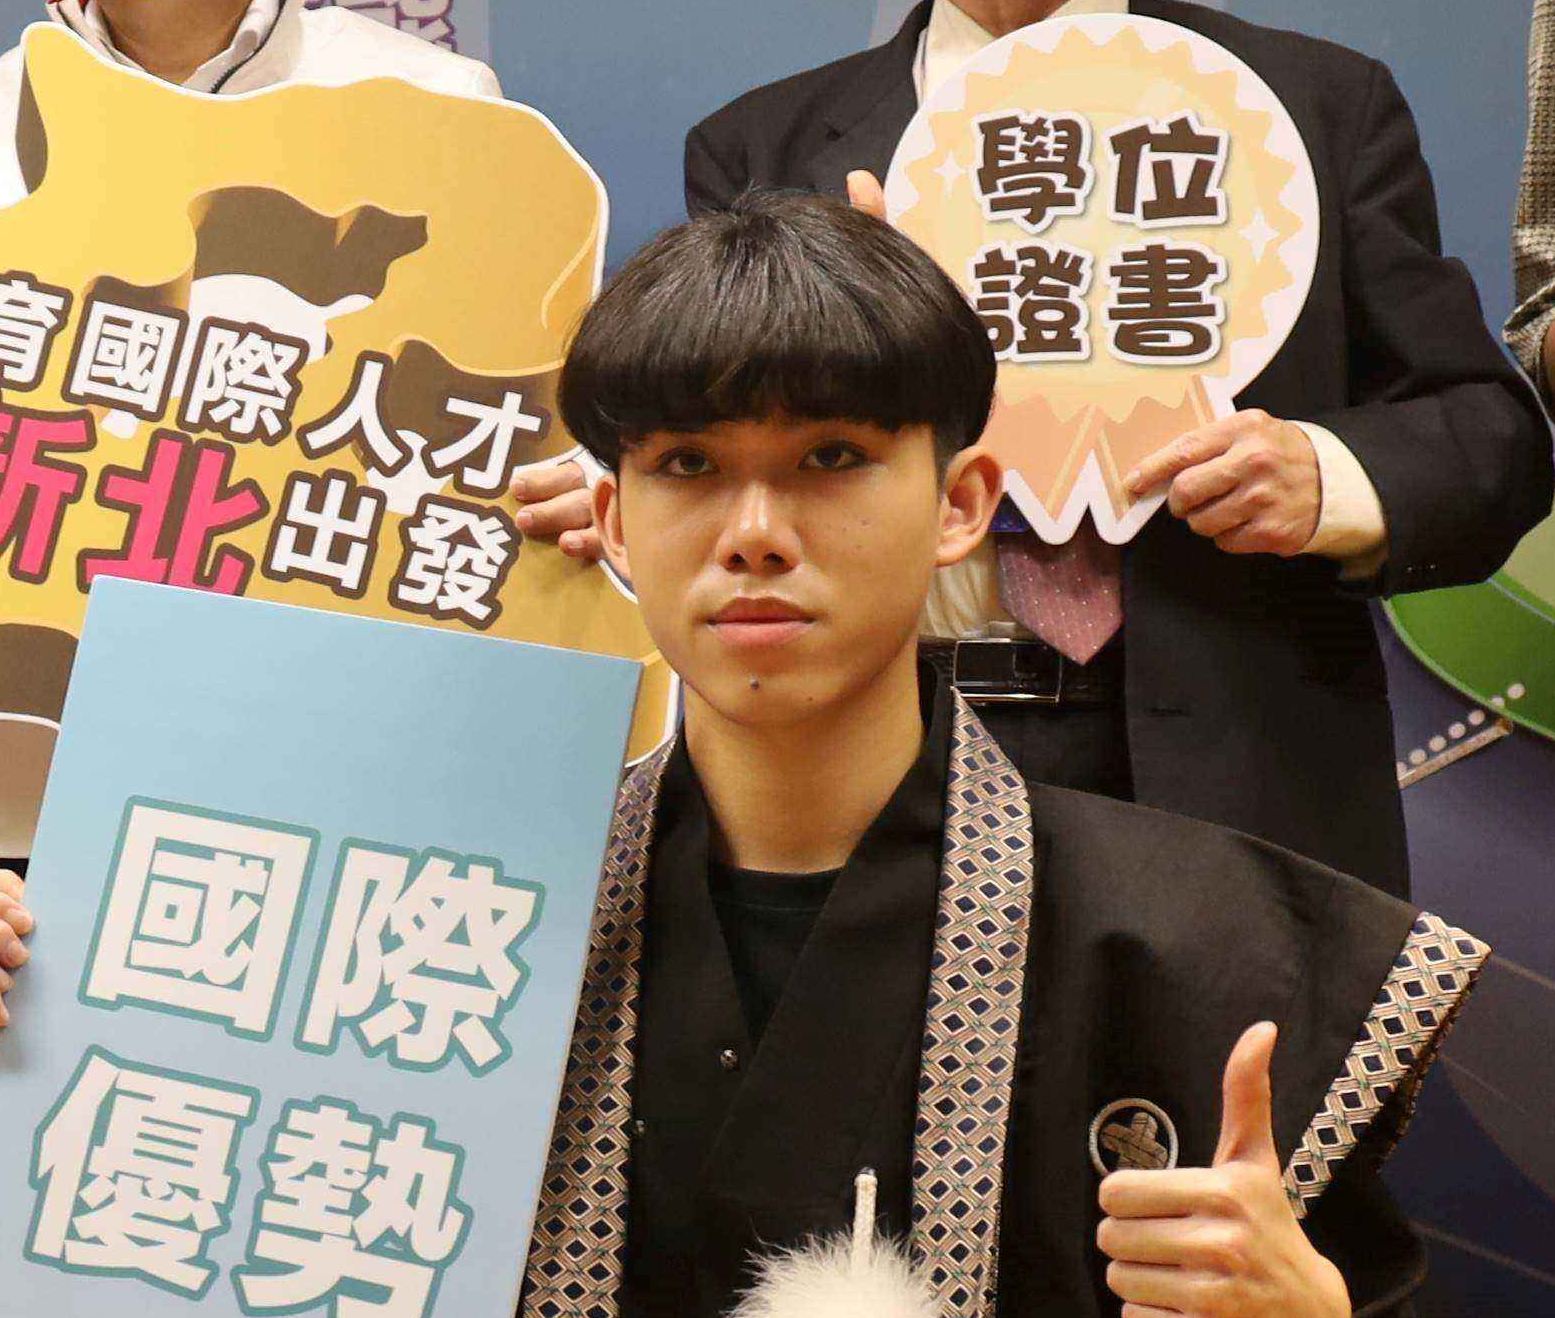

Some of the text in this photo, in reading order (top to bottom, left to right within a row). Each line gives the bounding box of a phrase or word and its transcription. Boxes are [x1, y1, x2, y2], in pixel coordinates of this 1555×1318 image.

[974, 115, 1225, 227] 學位
[974, 242, 1225, 365] 證書
[78, 794, 545, 1078] 國際
